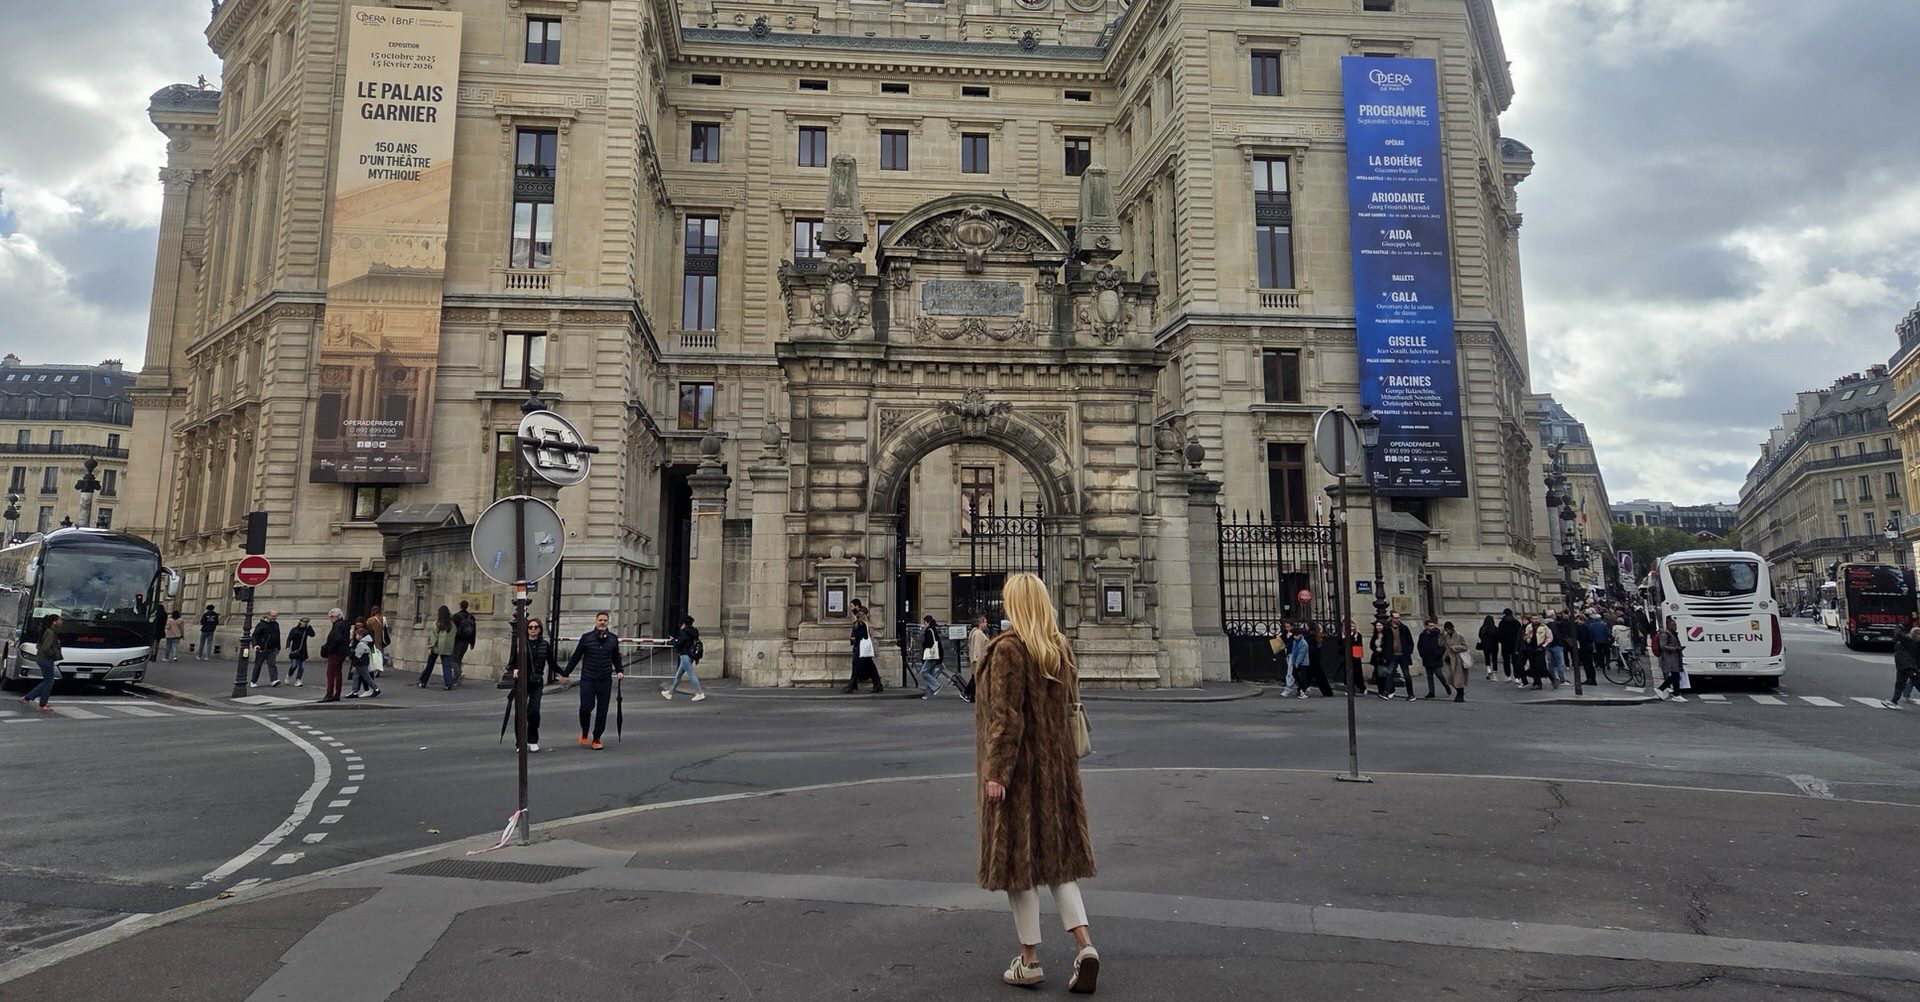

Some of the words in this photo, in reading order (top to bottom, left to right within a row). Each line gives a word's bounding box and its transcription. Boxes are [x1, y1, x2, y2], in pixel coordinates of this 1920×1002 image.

[372, 60, 381, 68] 15
[383, 60, 411, 68] février
[413, 62, 434, 70] 2026
[416, 55, 436, 64] 2025
[1369, 69, 1412, 86] OPÉRA
[358, 81, 378, 98] LE
[381, 82, 444, 102] PALAIS
[360, 102, 438, 123] GARNIER
[1359, 104, 1426, 118] PROGRAMME
[375, 142, 394, 153] 150
[396, 143, 418, 154] ANS
[360, 154, 384, 166] D'UN
[386, 154, 431, 168] THÉÂTRE
[1369, 156, 1382, 166] LA
[1384, 154, 1423, 167] BOHÈME
[368, 168, 421, 182] MYTHIQUE
[1371, 192, 1426, 203] ARIODANTE
[1388, 336, 1427, 347] GISELLE
[1706, 633, 1764, 642] TELEFUN
